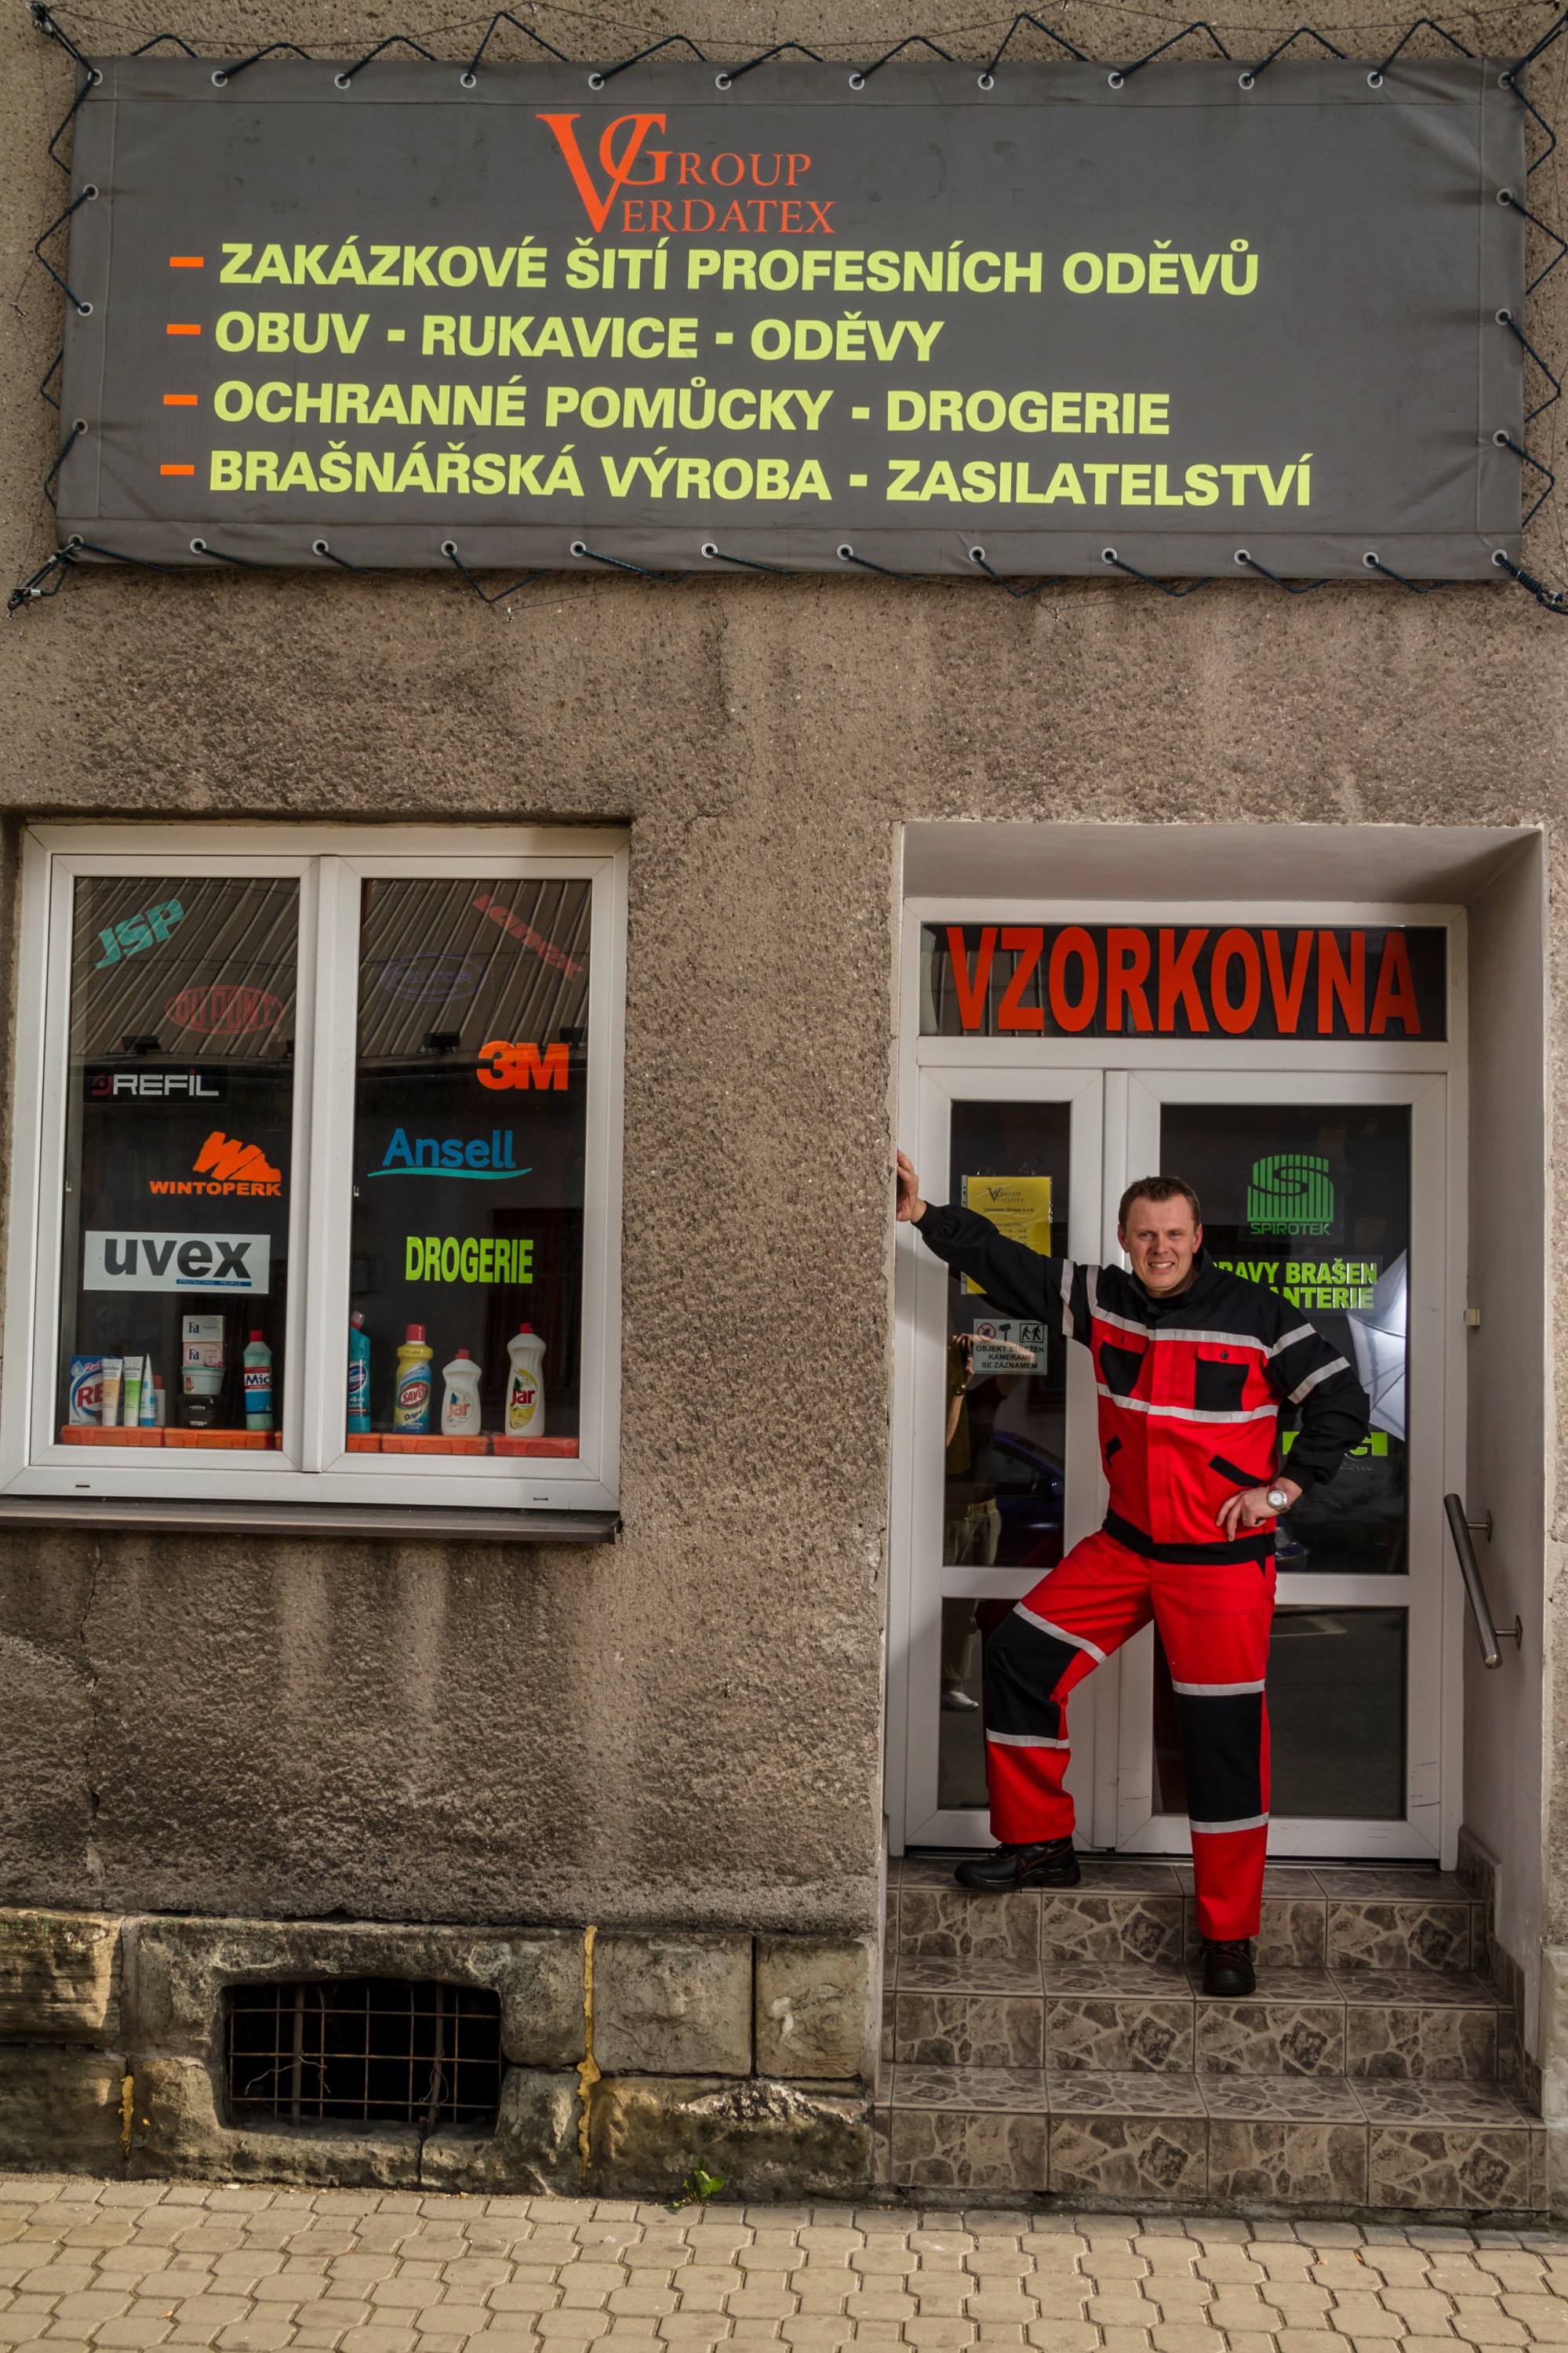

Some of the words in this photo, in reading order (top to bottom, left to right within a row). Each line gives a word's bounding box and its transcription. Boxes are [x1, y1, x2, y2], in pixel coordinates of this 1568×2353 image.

[599, 114, 811, 187] GROUP
[536, 114, 836, 235] VERDATEX
[219, 235, 548, 289] ZAKÁZKOVÉ
[565, 236, 668, 290] ŠITÍ
[687, 239, 1043, 293] PROFESNÍCH
[1062, 238, 1260, 296] ODĚVŮ
[215, 311, 370, 355] OBUV
[421, 315, 699, 359] RUKAVICE
[750, 311, 945, 362] ODĚVY
[213, 374, 527, 427] OCHRANNÉ
[545, 376, 834, 431] POMŮCKY
[886, 390, 1170, 435] DROGERIE
[209, 440, 584, 497] BRAŠNÁŘSKÁ
[600, 446, 832, 501] VÝROBA
[886, 453, 1312, 507] ZASILATELSTVÍ
[95, 899, 184, 969] JSP
[391, 971, 473, 984] PELTOR
[946, 926, 1422, 1035] VZORKOVNA
[476, 1040, 569, 1090] 3M
[382, 1128, 516, 1168] Ansell
[149, 1180, 282, 1197] WINTOPERK
[1250, 1222, 1333, 1236] SPIROTEK
[104, 1238, 253, 1279] uvex
[406, 1236, 533, 1284] DROGERIE
[1286, 1257, 1377, 1285] BRAŠEN
[188, 1322, 200, 1333] Fa
[188, 1348, 200, 1360] Fa
[994, 1361, 1038, 1369] ZÁZNAMEM
[1009, 1344, 1045, 1353] STŘEŽEN
[402, 1386, 426, 1404] SAVO
[446, 1400, 471, 1419] Jar
[510, 1387, 536, 1406] Jar
